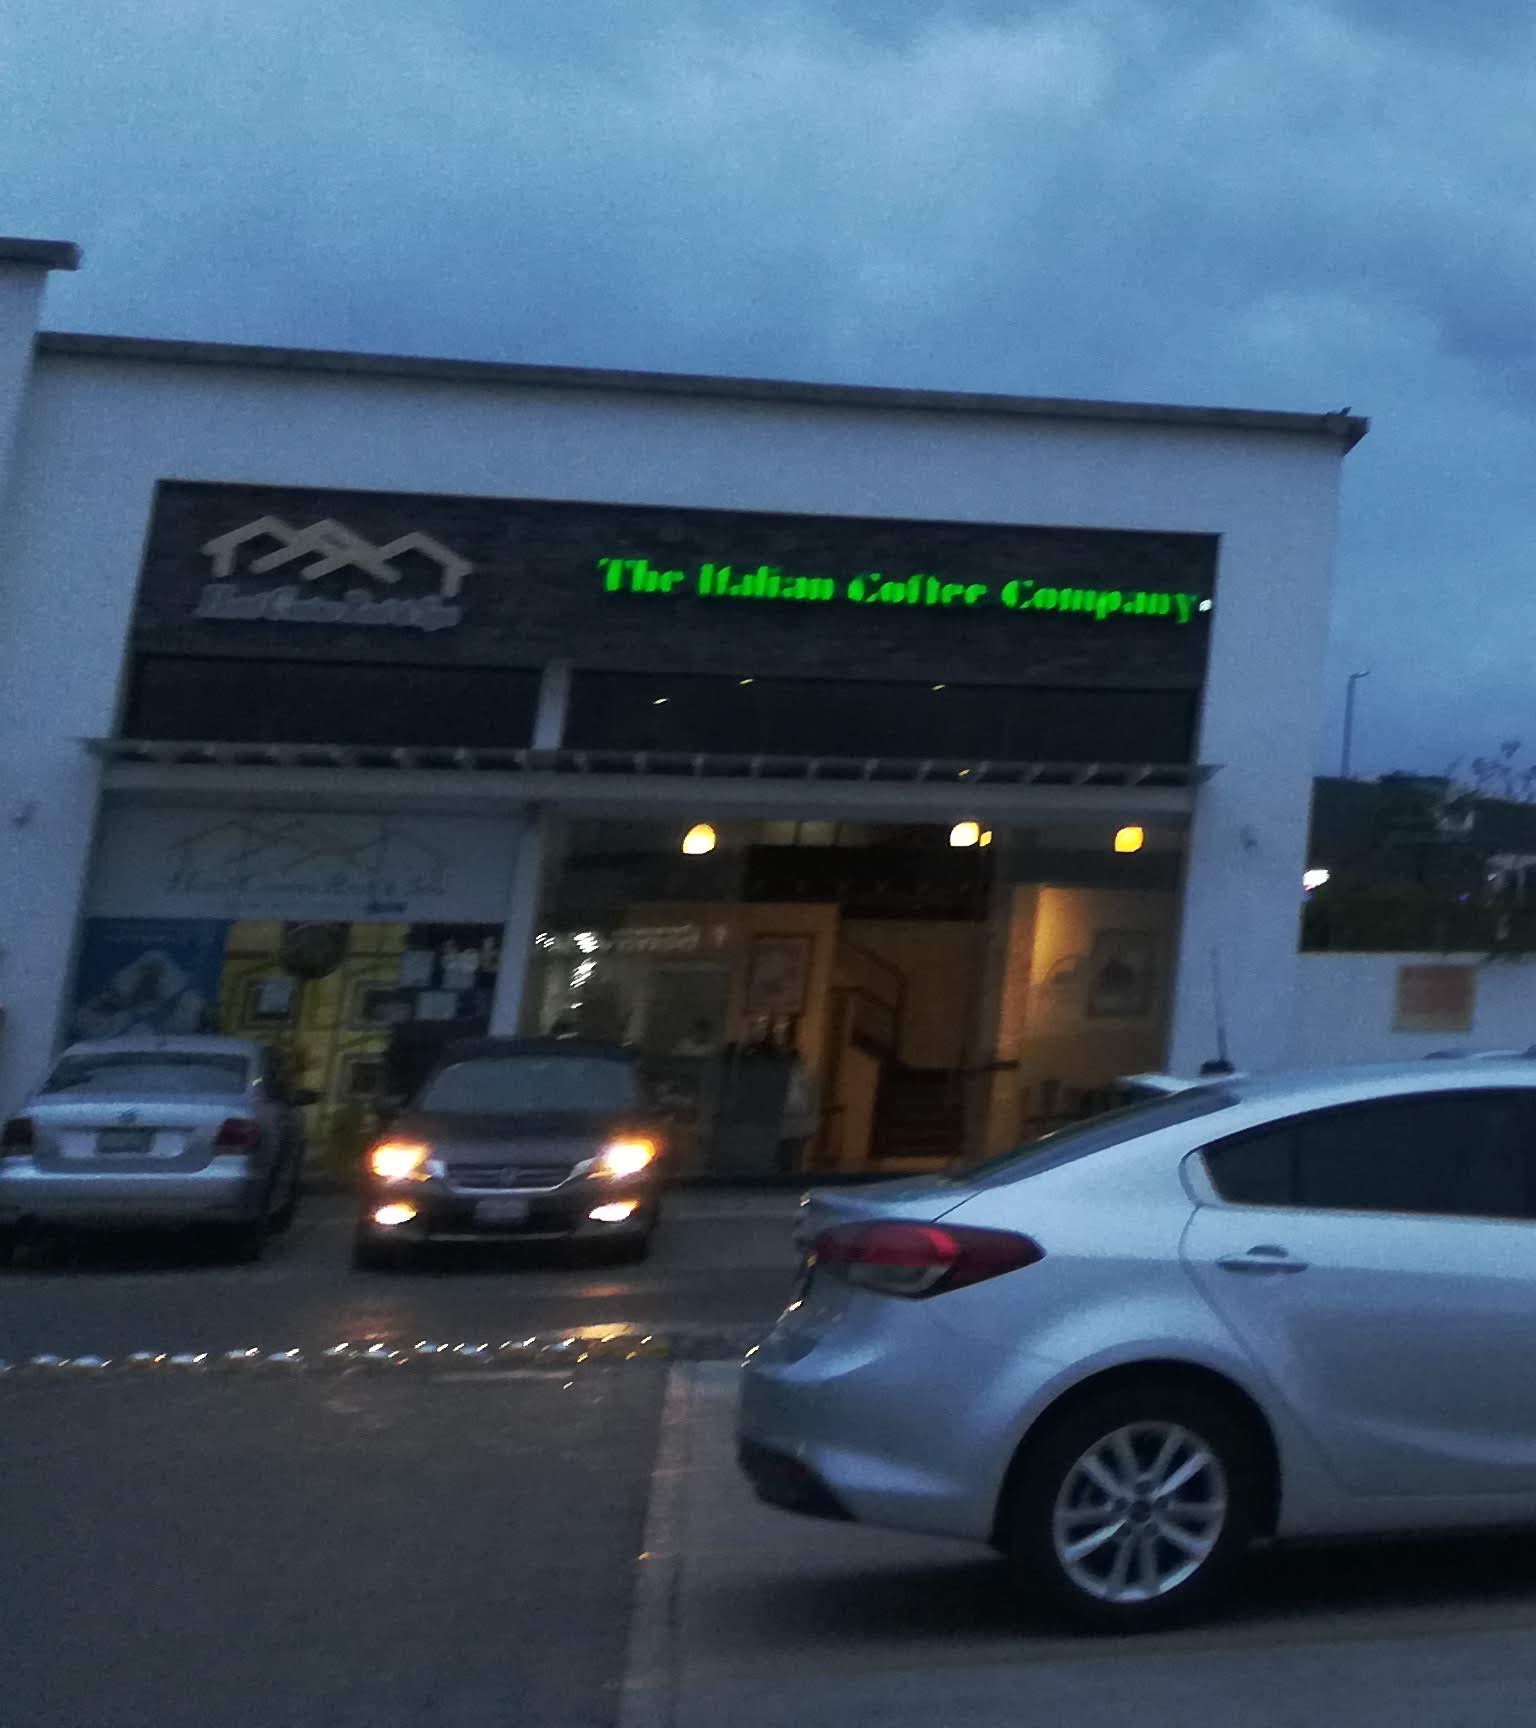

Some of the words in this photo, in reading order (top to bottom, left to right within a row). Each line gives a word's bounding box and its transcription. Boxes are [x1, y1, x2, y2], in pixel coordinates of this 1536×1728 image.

[598, 558, 684, 593] The
[698, 562, 834, 601] Italian
[846, 572, 987, 605] Coffee
[1000, 579, 1195, 623] Company
